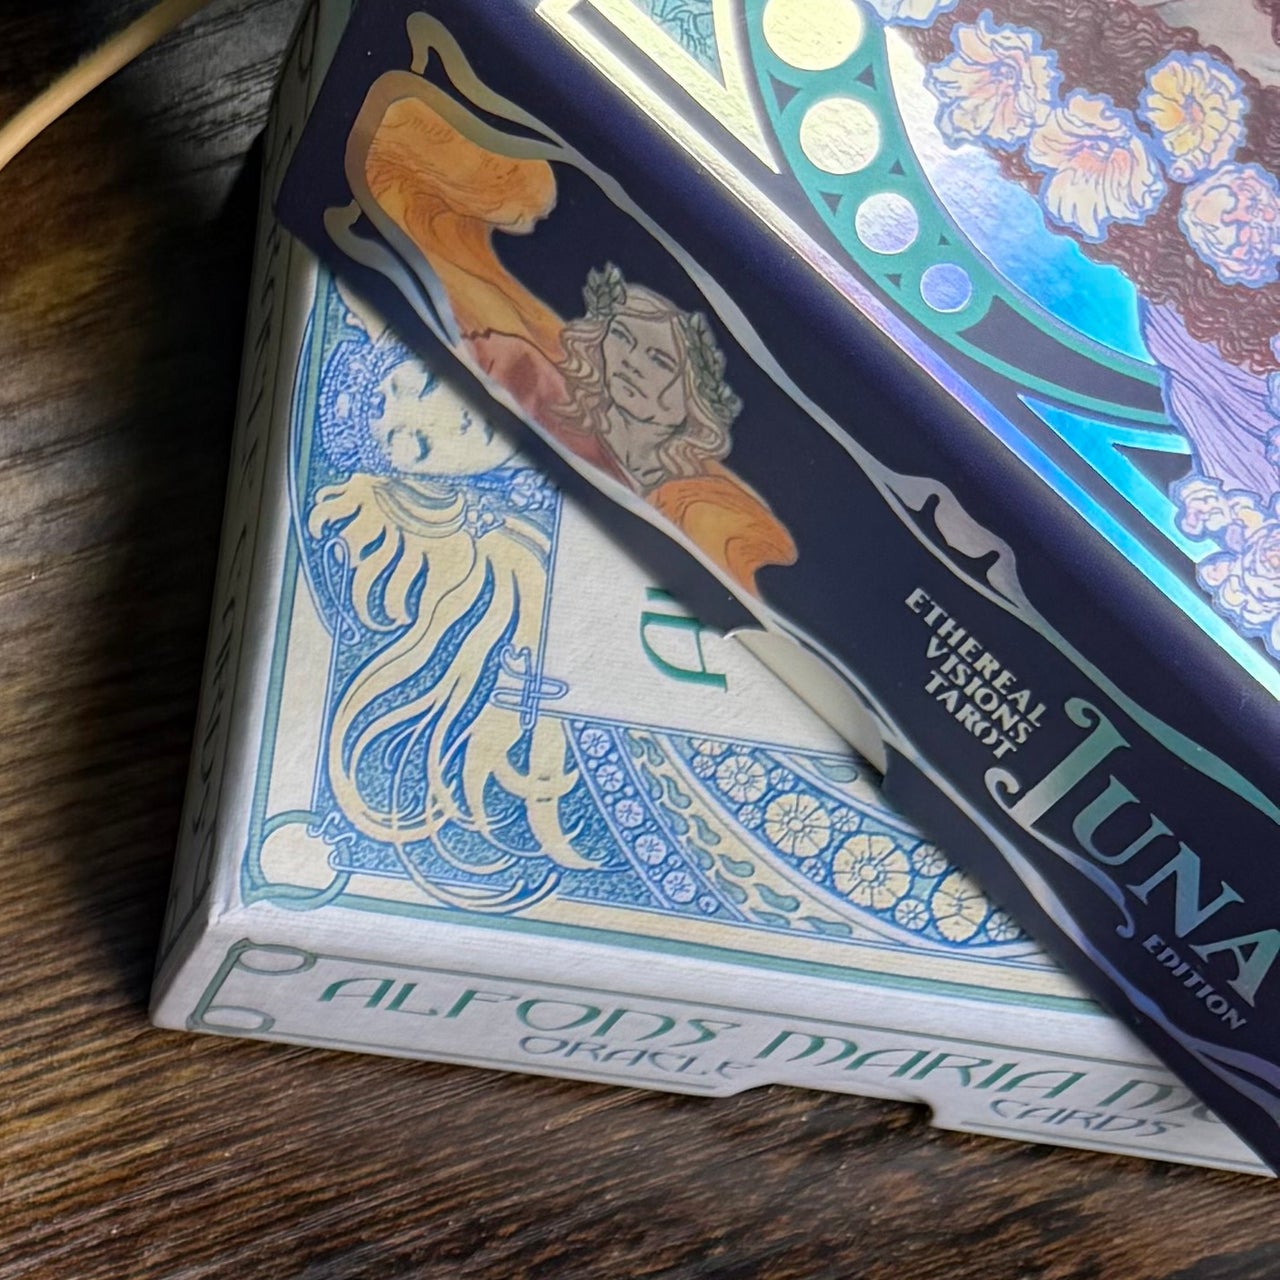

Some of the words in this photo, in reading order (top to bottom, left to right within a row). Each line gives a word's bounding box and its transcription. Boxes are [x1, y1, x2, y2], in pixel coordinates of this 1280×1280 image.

[904, 587, 1047, 728] ETHEREAL
[925, 635, 1034, 745] VISIONS
[924, 669, 1018, 760] TAROT
[984, 697, 1280, 1008] LUNA
[1141, 933, 1248, 1031] EDITION
[318, 977, 742, 1049] ALFONS
[754, 1030, 1089, 1100] MARIA
[518, 1035, 758, 1080] ORACLE
[989, 1098, 1186, 1138] CARDS
